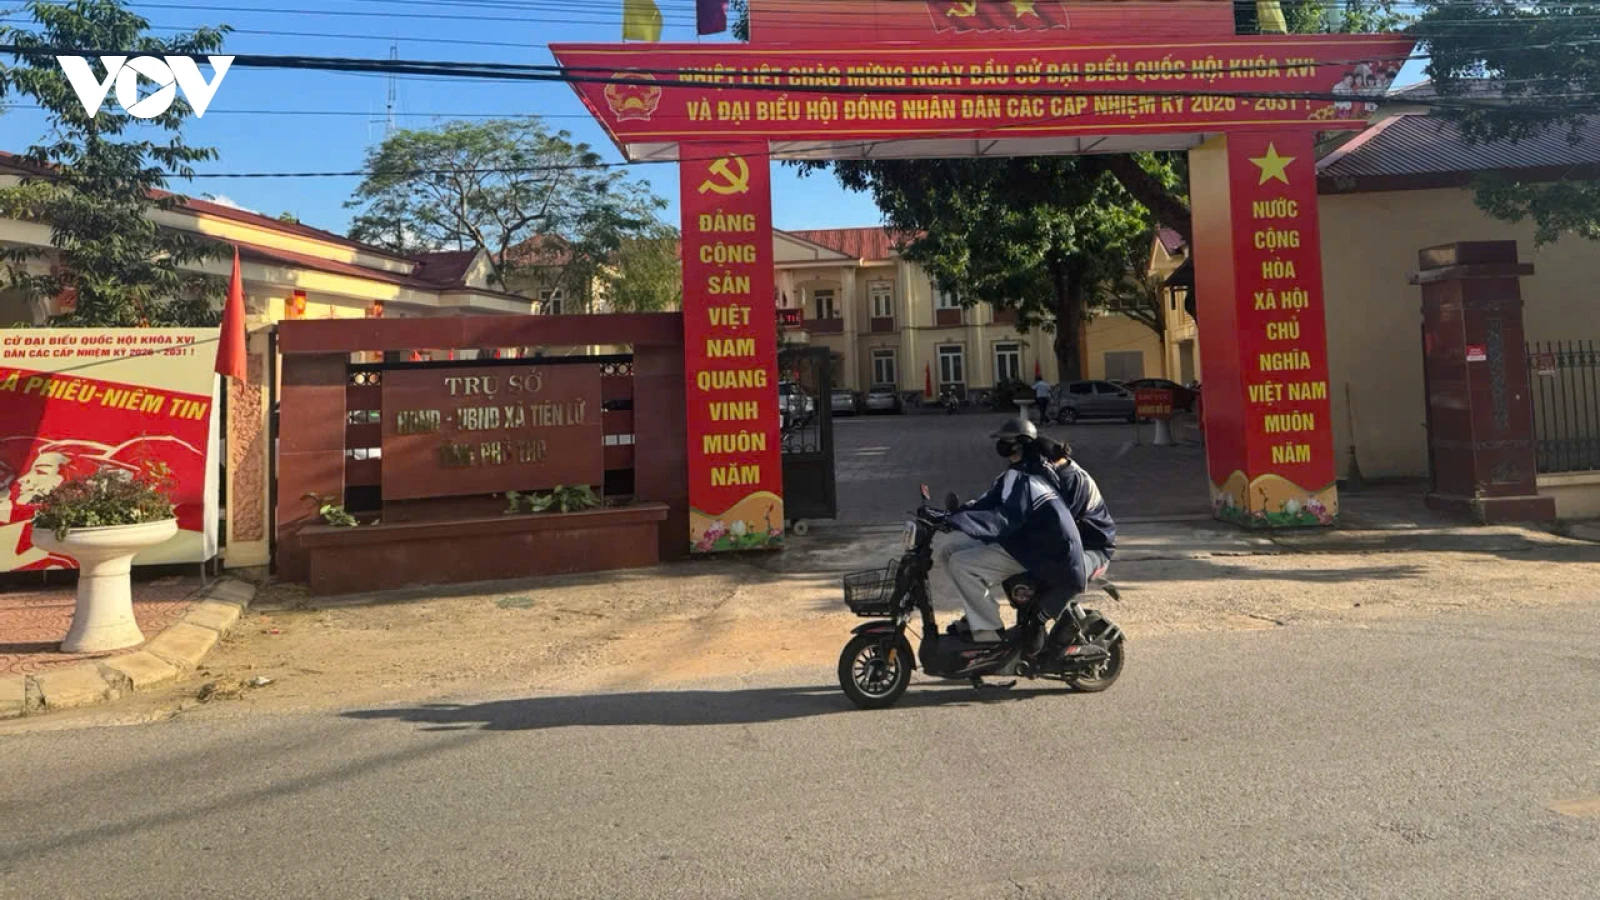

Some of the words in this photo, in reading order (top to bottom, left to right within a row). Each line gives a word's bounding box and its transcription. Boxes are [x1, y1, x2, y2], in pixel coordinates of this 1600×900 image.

[678, 63, 736, 91] NHIỆT
[788, 63, 841, 86] CHÀO
[847, 62, 906, 86] MỪNG
[911, 61, 964, 86] NGÀY
[969, 58, 1010, 85] BẦU
[1014, 58, 1043, 84] CỬ
[1046, 63, 1080, 87] ĐẠI
[1084, 54, 1129, 82] BIỂU
[1134, 53, 1186, 83] QUỐC
[1191, 55, 1224, 84] HỘI
[1229, 55, 1281, 79] KHÓA
[1285, 58, 1316, 78] XVI
[686, 97, 713, 121] VÀ
[717, 100, 750, 125] ĐẠI
[756, 93, 801, 121] BIỂU
[806, 96, 839, 125] HỘI
[844, 93, 897, 120] ĐỒNG
[902, 95, 956, 120] NHÂN
[961, 95, 1001, 119] DÂN
[1006, 95, 1045, 118] CÁC
[1190, 94, 1236, 112] 2026
[1252, 196, 1298, 218] NƯỚC
[699, 208, 756, 232] ĐẢNG
[1254, 226, 1300, 253] CỘNG
[700, 241, 757, 267] CỘNG
[1262, 256, 1297, 279] HÒA
[707, 269, 751, 295] SẢN
[1254, 288, 1277, 311] XÃ
[1281, 286, 1309, 312] HỘI
[708, 303, 752, 330] VIỆT
[1266, 315, 1300, 340] CHỦ
[163, 347, 187, 357] 2031
[176, 335, 196, 345] XVI
[706, 338, 756, 357] NAM
[1260, 348, 1311, 371] NGHĨA
[444, 375, 500, 400] TRỤ
[697, 369, 768, 392] QUANG
[1248, 380, 1283, 406] VIỆT
[1288, 381, 1328, 401] NAM
[0, 369, 21, 393] Á
[169, 397, 208, 421] TIN
[456, 405, 500, 431] UBND
[709, 401, 759, 421] VINH
[1264, 410, 1315, 433] MUÔN
[703, 429, 767, 454] MUÔN
[1271, 441, 1311, 464] NĂM
[711, 462, 760, 486] NĂM
